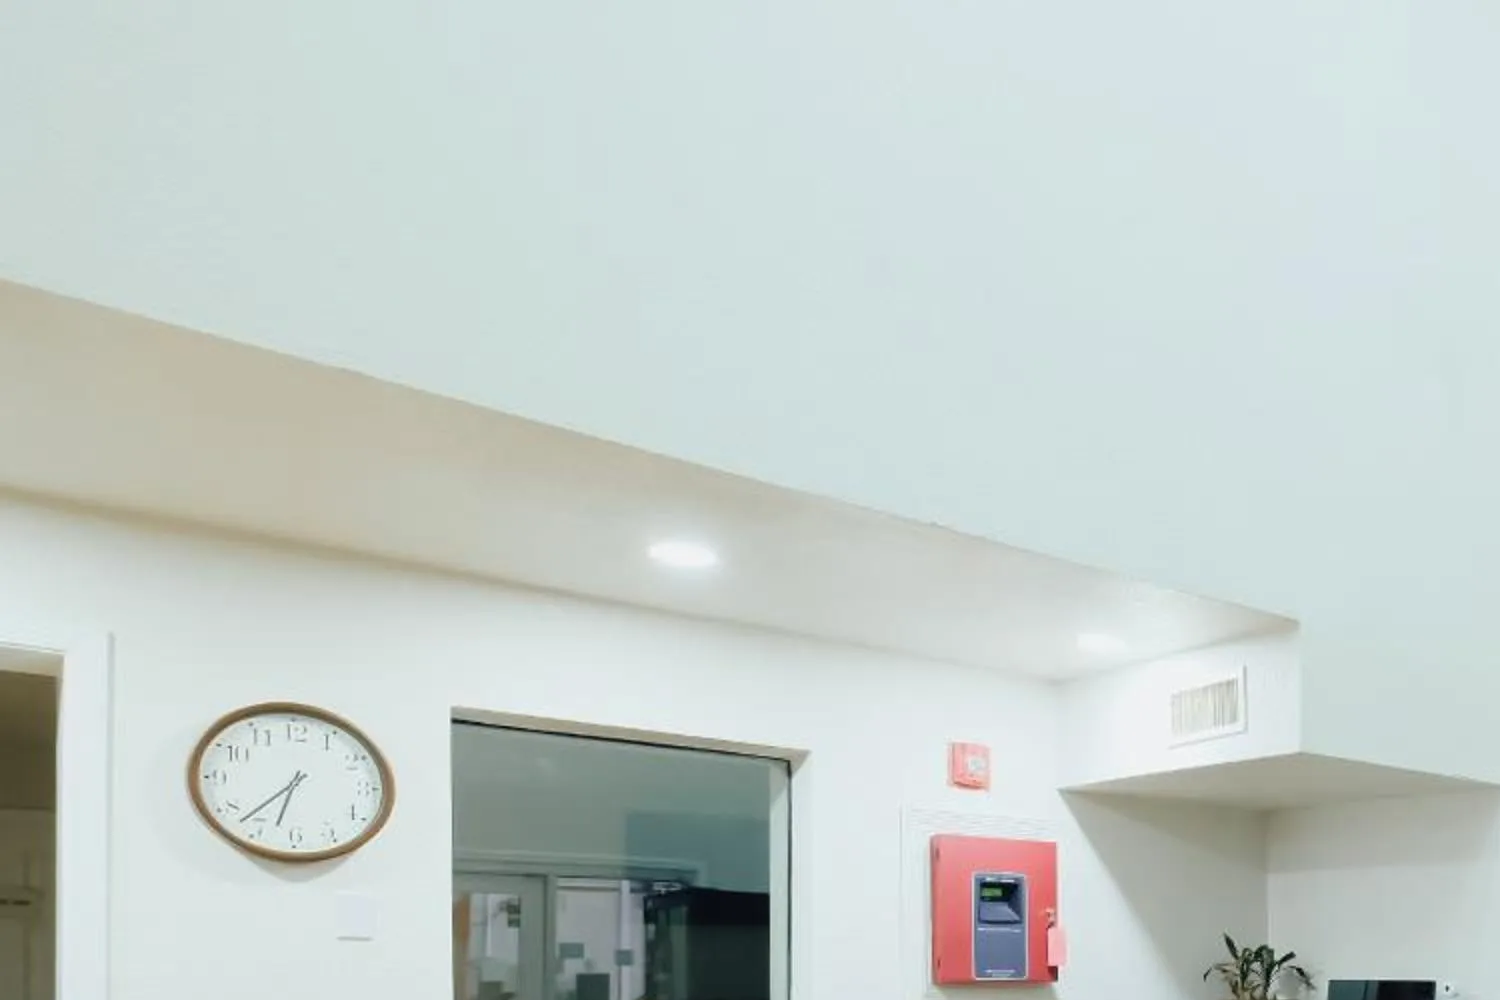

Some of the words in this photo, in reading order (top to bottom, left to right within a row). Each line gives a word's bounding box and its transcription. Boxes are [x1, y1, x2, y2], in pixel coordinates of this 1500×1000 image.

[253, 728, 272, 747] 11
[286, 723, 308, 743] 12
[226, 745, 250, 763] 10
